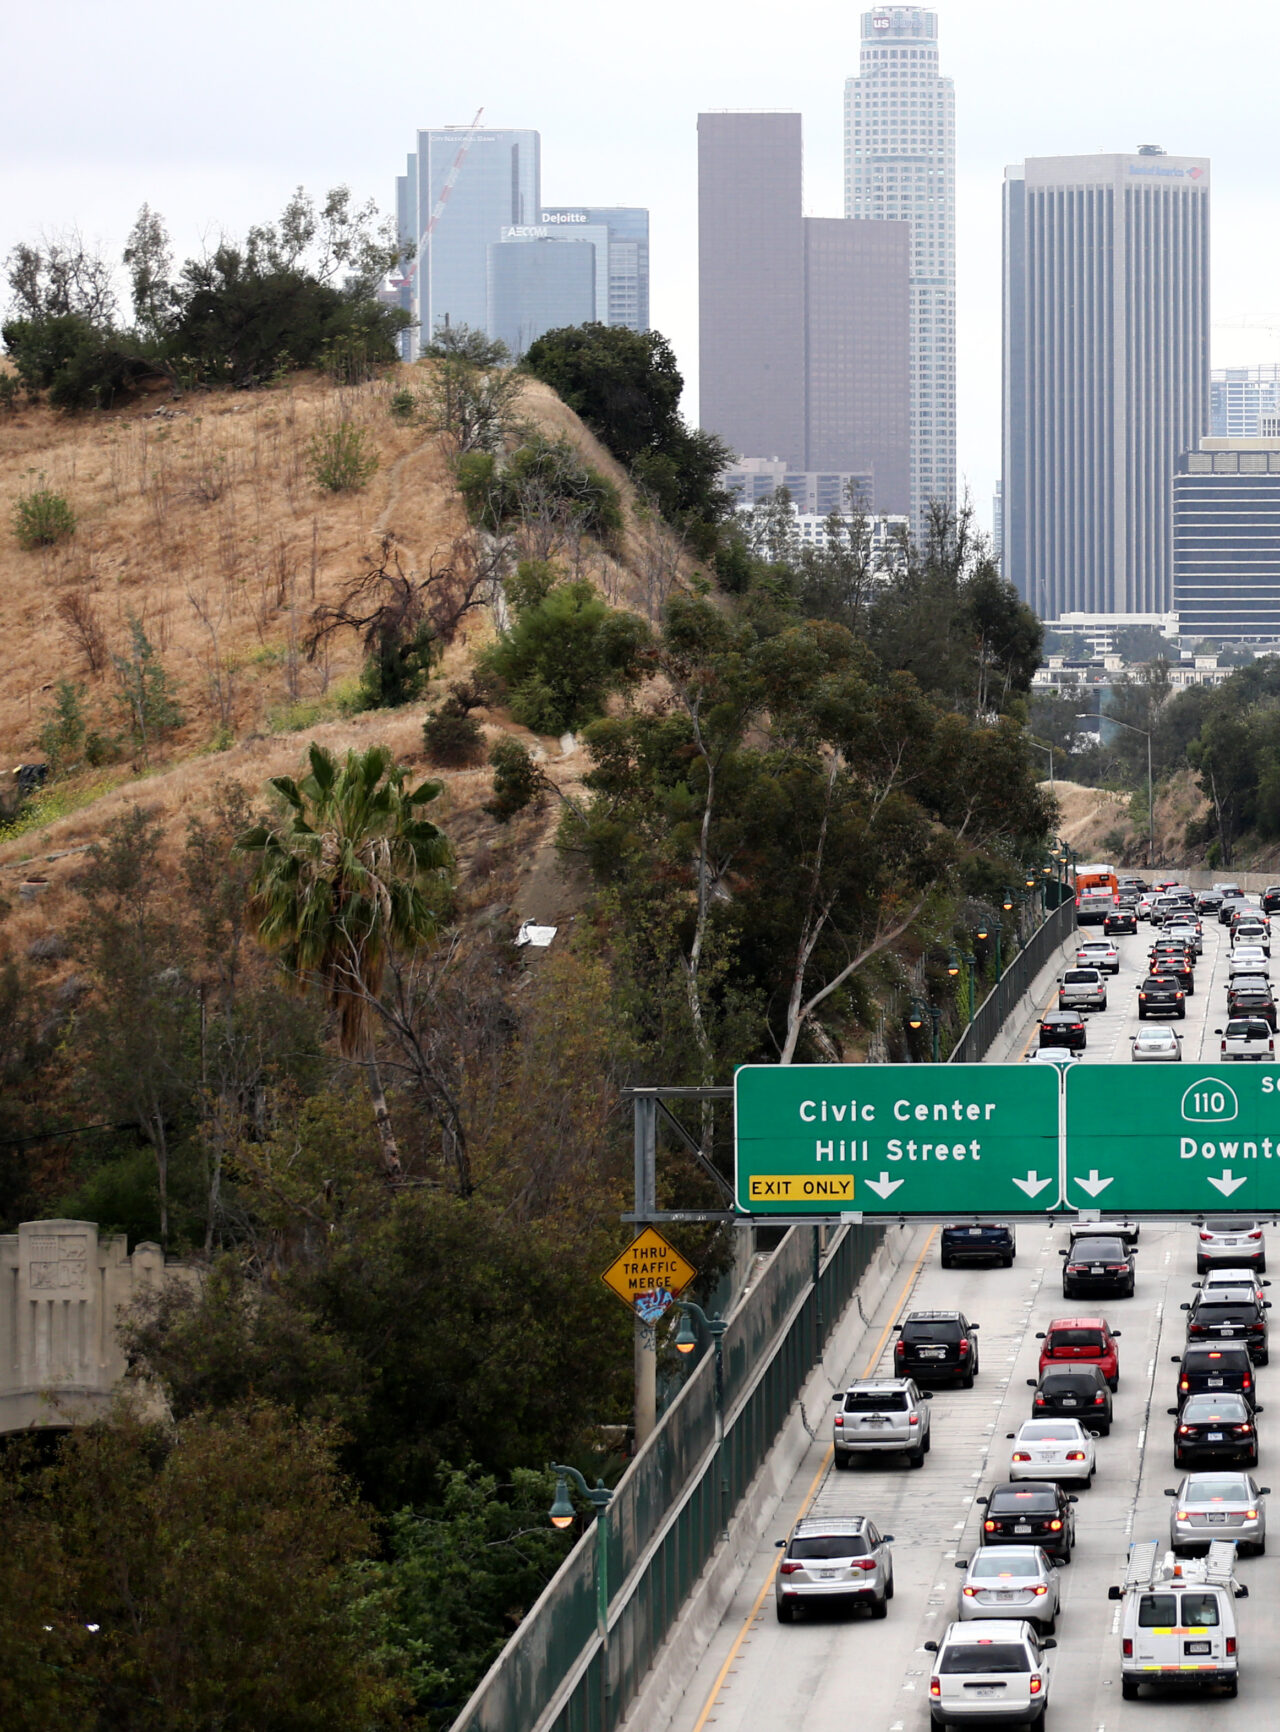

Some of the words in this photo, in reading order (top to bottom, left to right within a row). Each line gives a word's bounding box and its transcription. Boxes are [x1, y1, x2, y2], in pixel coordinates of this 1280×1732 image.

[799, 1099, 875, 1122] Civic
[893, 1099, 996, 1122] Center
[1193, 1091, 1225, 1113] 110
[815, 1139, 869, 1162] Hill
[886, 1139, 982, 1162] Street
[751, 1181, 792, 1195] EXIT
[803, 1180, 851, 1195] ONLY
[623, 1261, 677, 1275] TRAFFIC
[628, 1276, 672, 1289] MERGE
